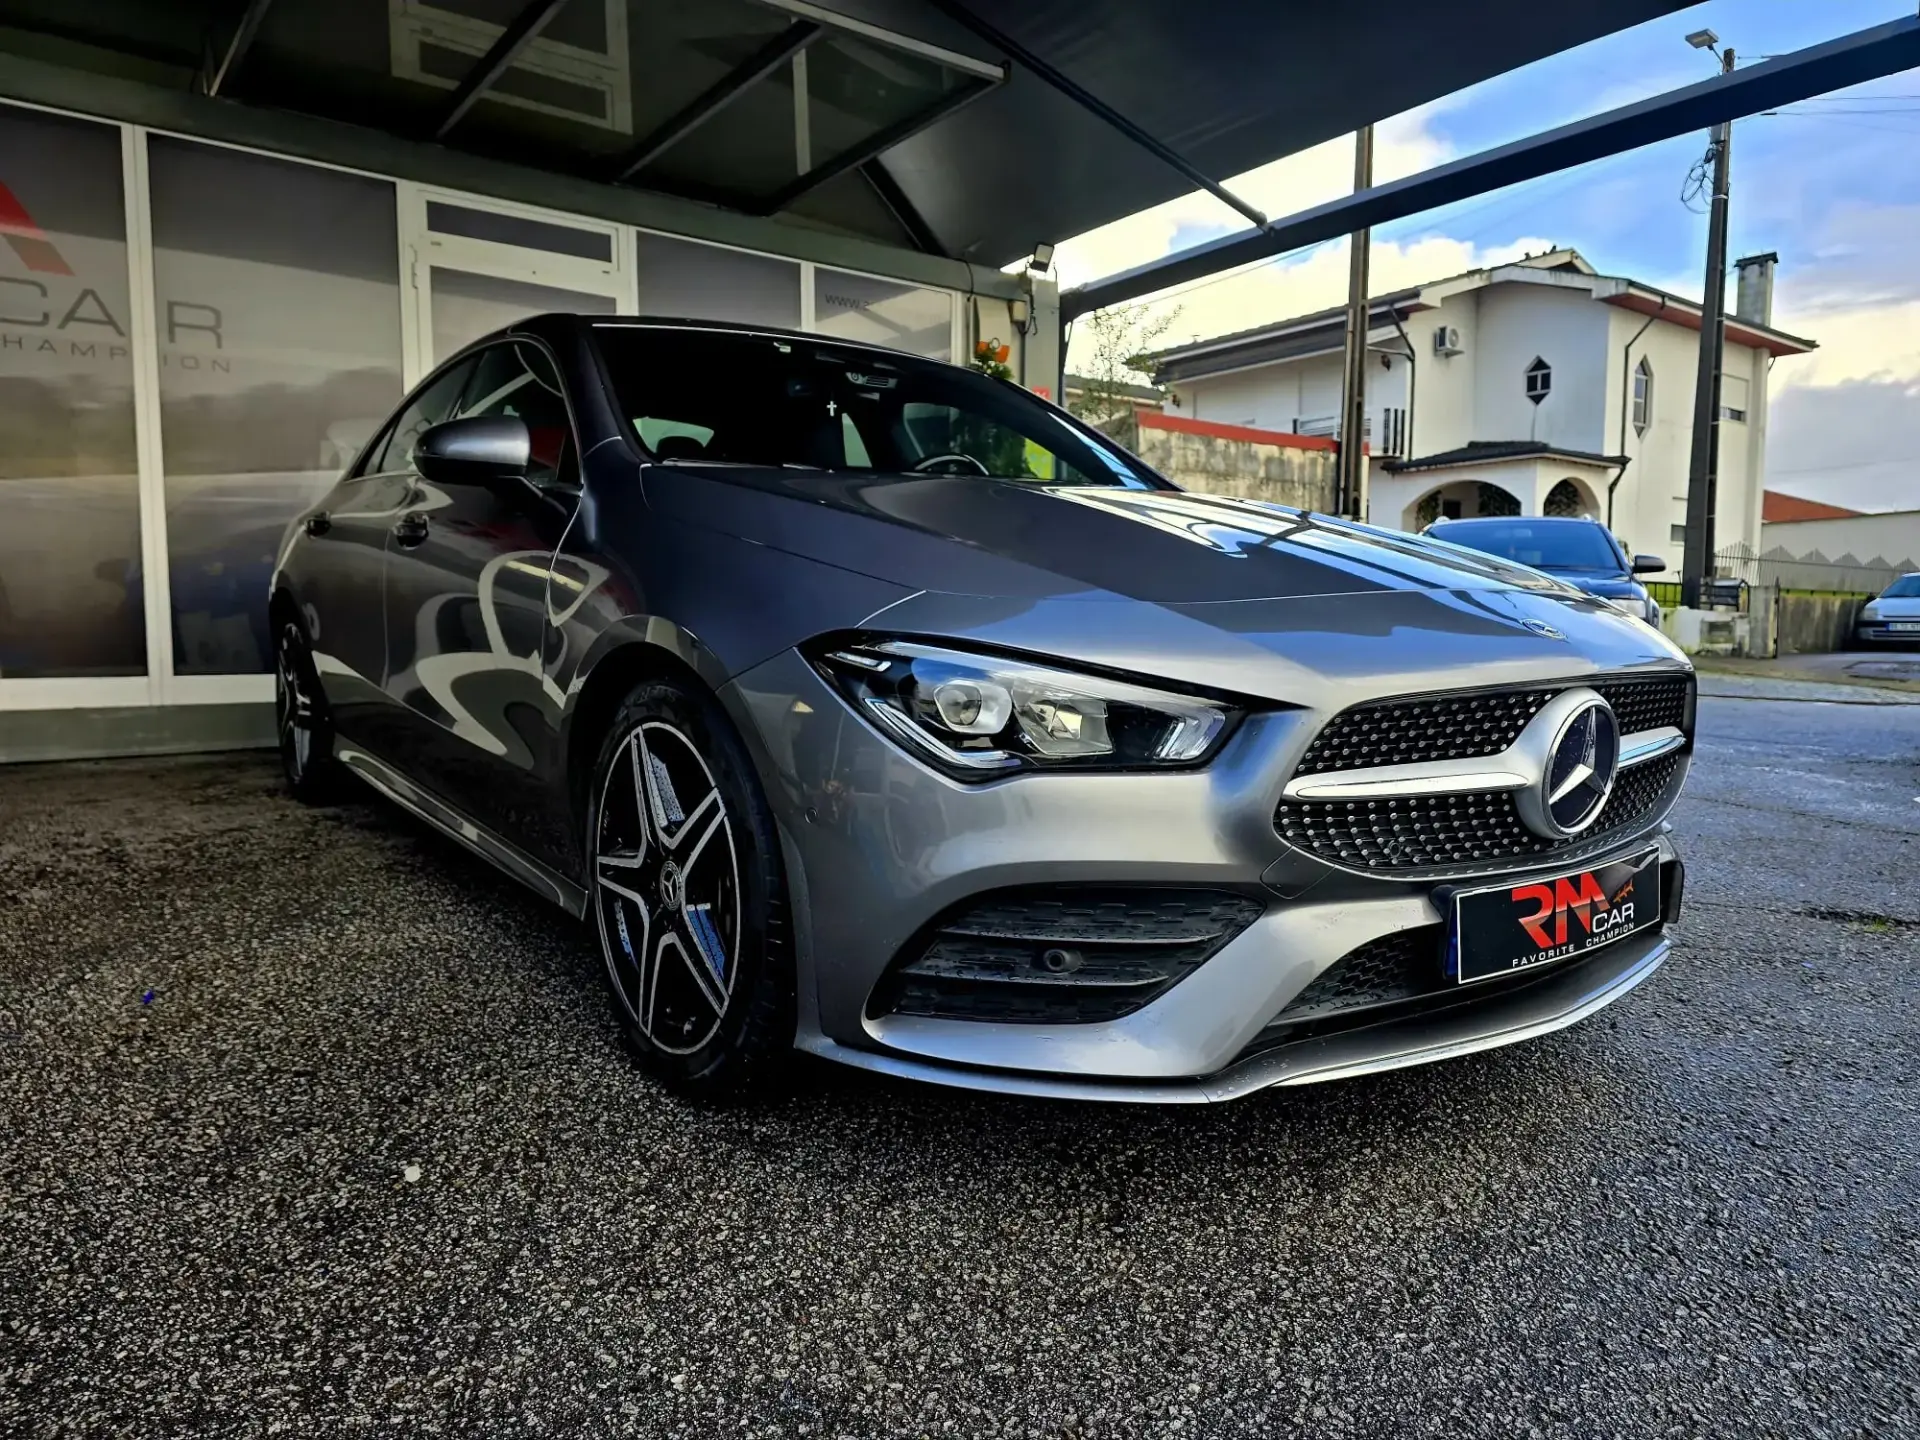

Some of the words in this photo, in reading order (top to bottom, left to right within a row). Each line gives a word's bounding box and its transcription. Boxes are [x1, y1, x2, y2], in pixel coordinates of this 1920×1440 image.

[2, 334, 230, 374] HAMPION
[1512, 871, 1610, 949] RM
[1592, 902, 1634, 933] CAR
[1512, 943, 1575, 968] FAVORITE
[1586, 922, 1635, 947] CHAMPION
